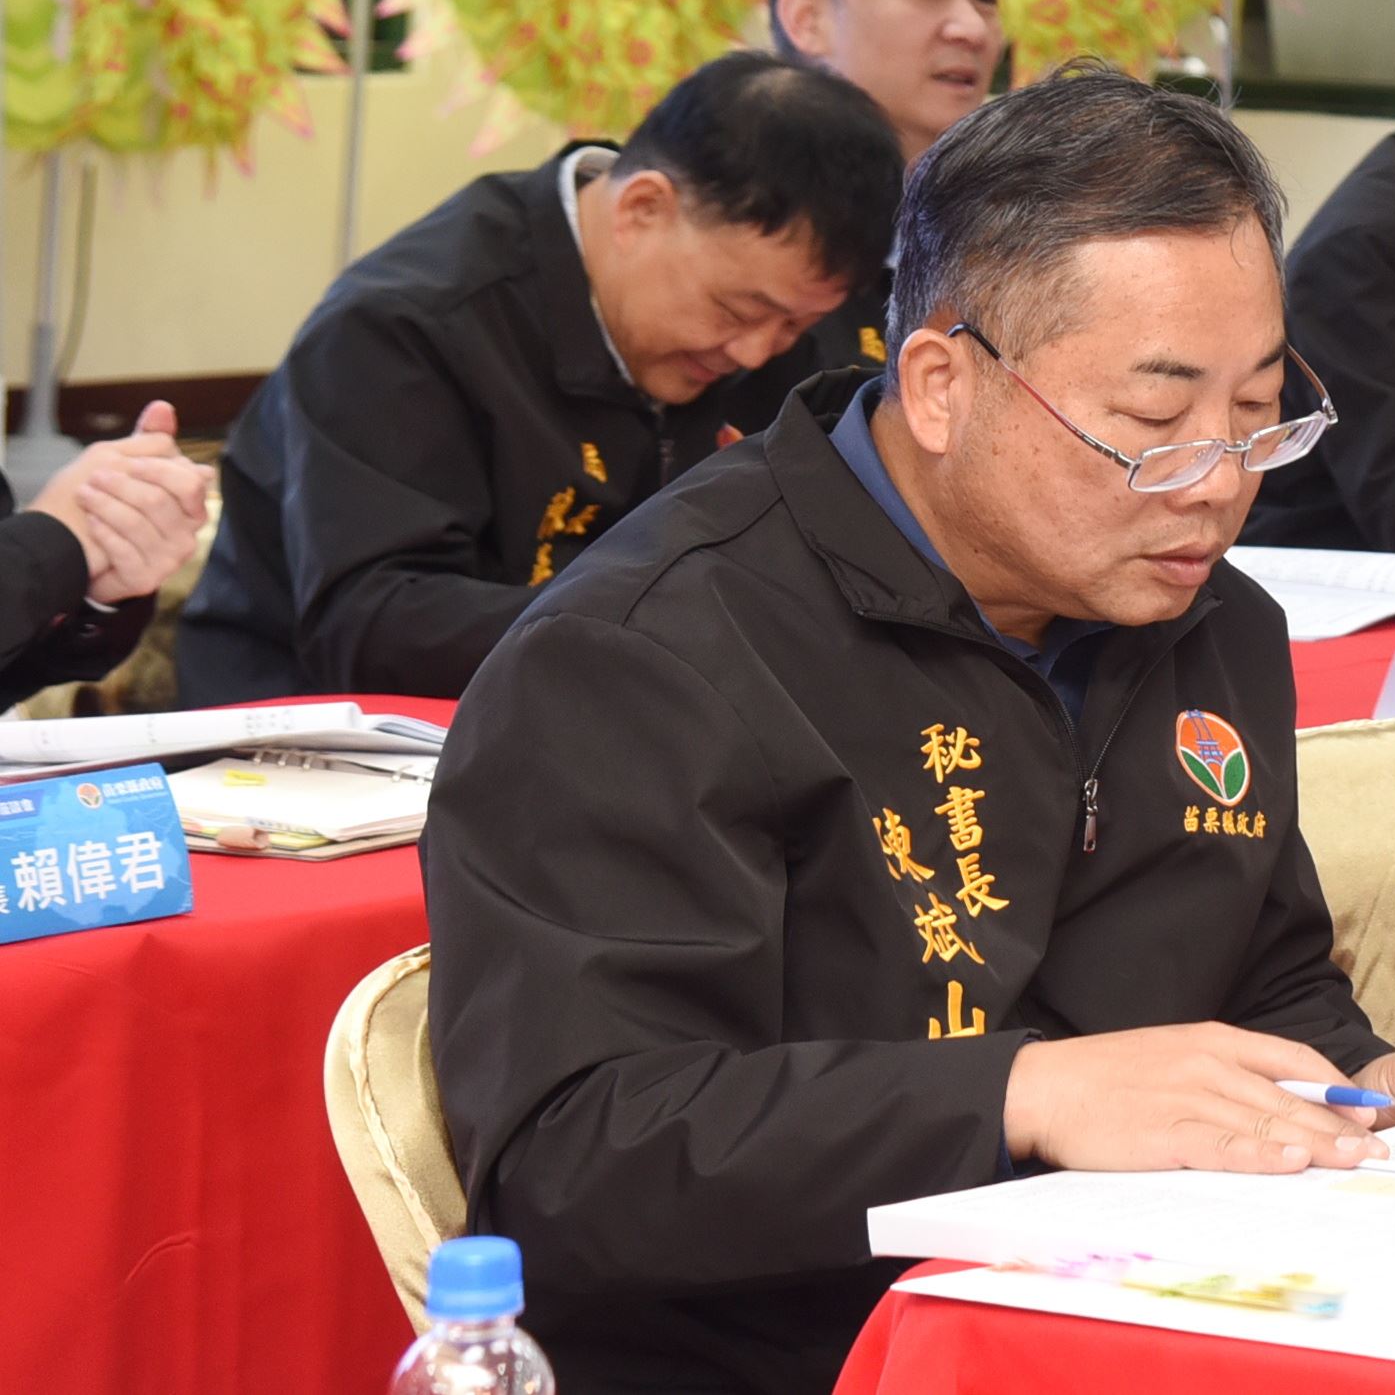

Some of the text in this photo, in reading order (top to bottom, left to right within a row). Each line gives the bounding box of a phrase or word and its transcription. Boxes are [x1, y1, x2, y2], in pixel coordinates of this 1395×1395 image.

[11, 831, 167, 912] 賴偉君
[920, 723, 1010, 917] 秘書長
[1184, 805, 1266, 838] 苗栗縣政府
[872, 807, 985, 1040] 陳斌山
